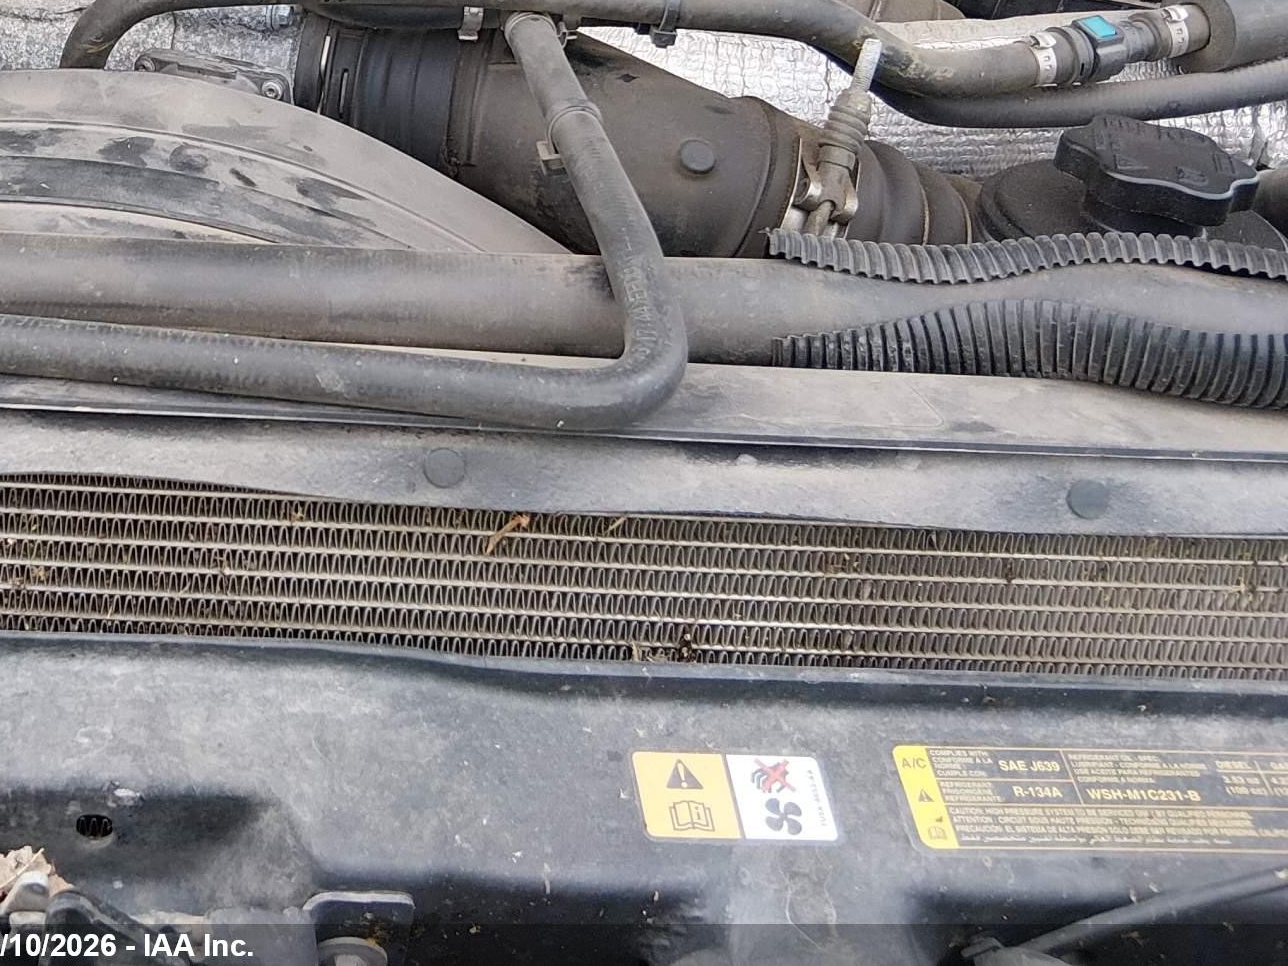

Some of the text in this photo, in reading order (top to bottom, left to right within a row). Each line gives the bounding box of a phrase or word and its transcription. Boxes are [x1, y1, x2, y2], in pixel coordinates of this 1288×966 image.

[900, 756, 927, 770] A/C
[998, 759, 1061, 773] SAE J639
[1012, 786, 1063, 798] R-134A
[1086, 788, 1201, 802] WSH-M1C231-B
